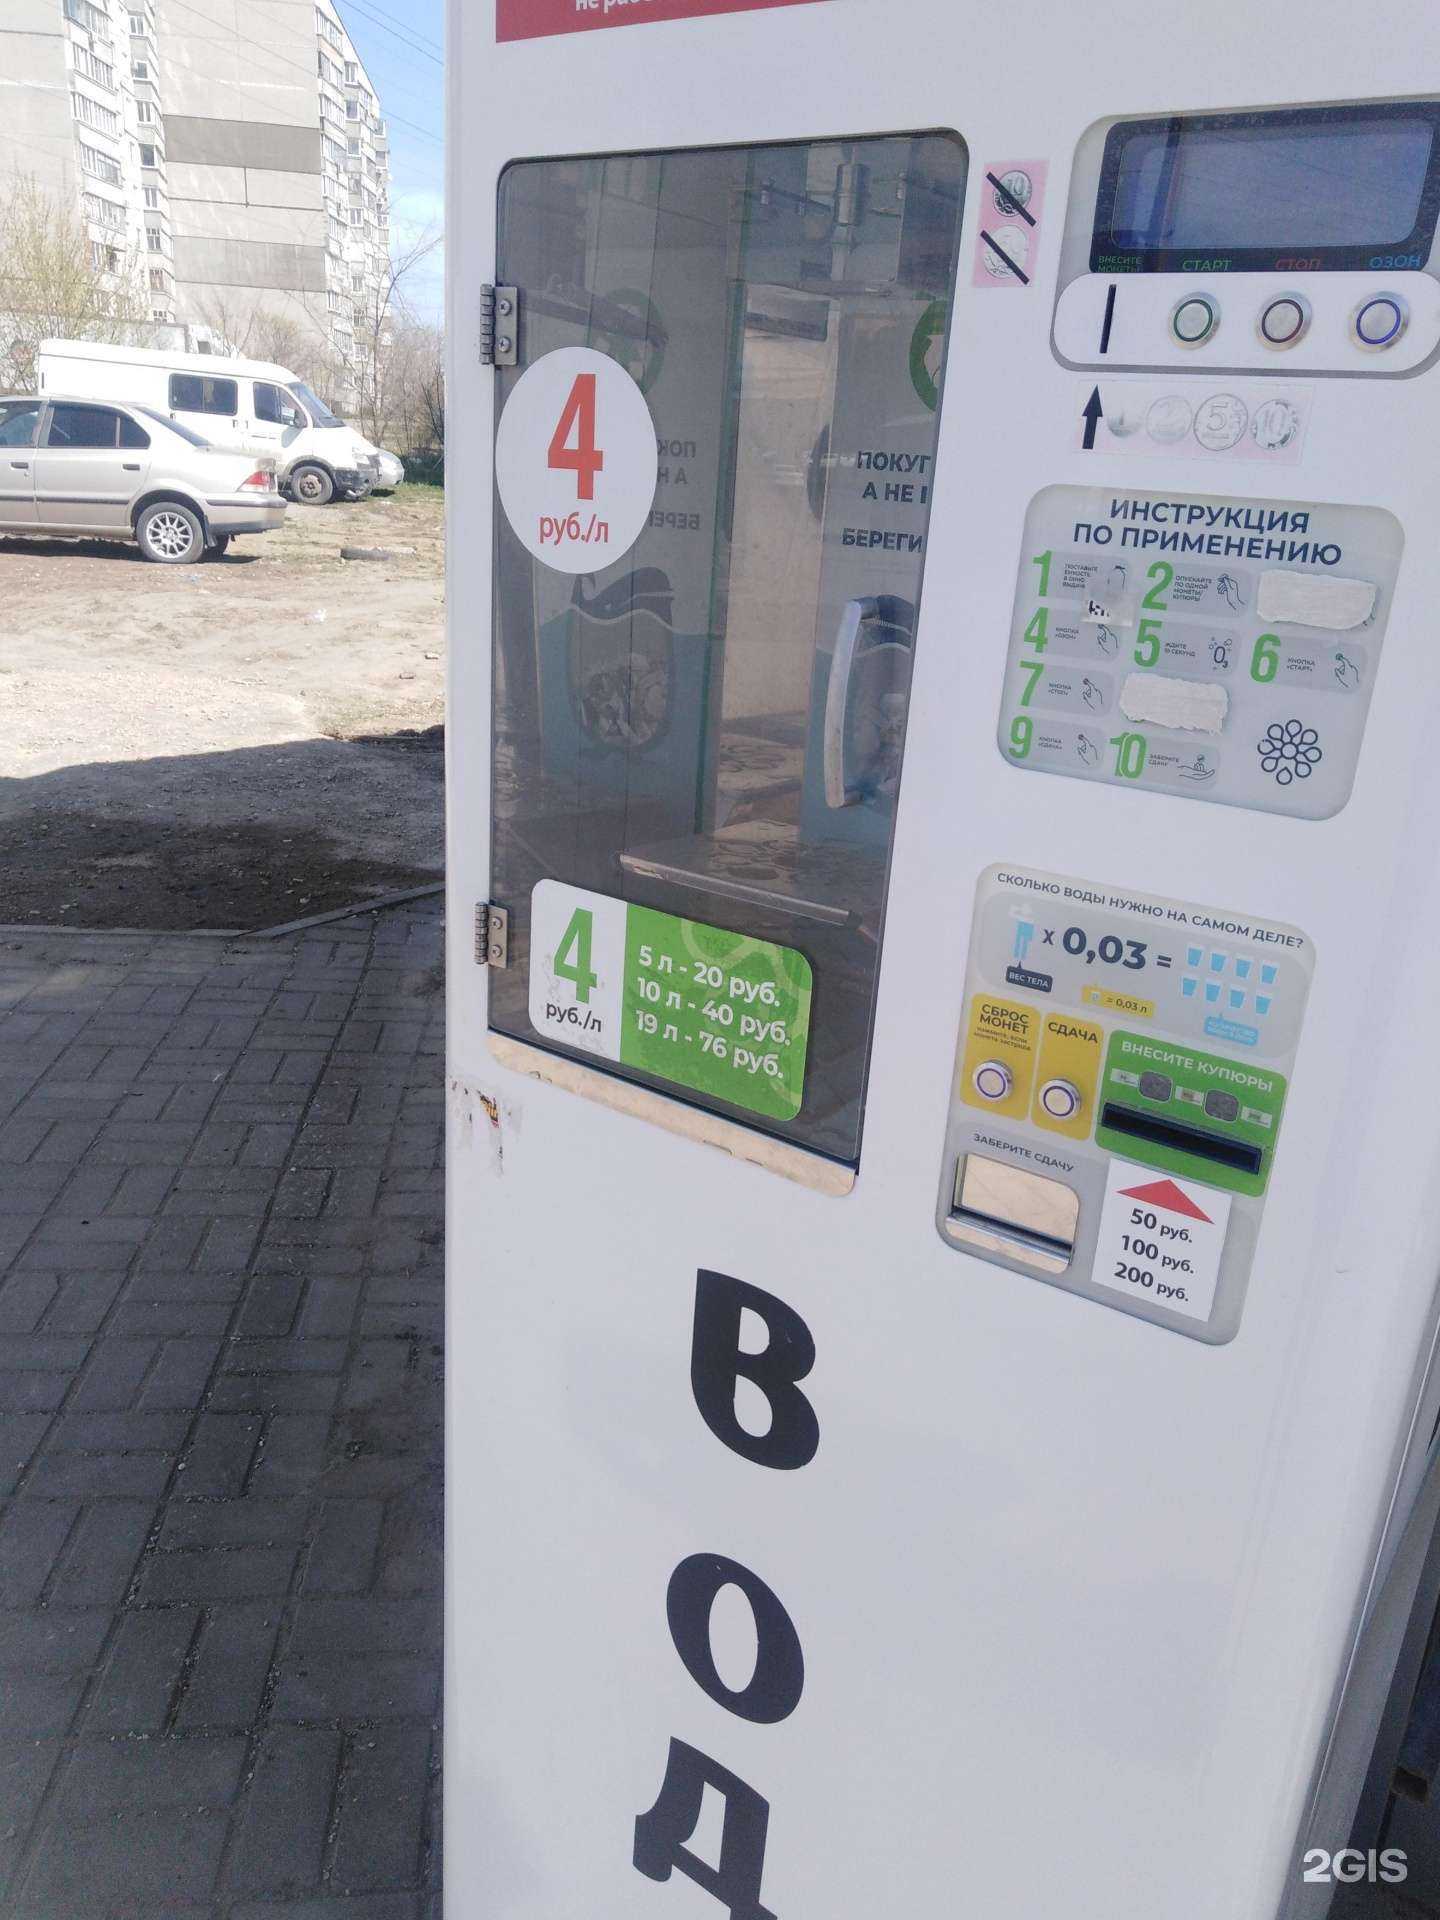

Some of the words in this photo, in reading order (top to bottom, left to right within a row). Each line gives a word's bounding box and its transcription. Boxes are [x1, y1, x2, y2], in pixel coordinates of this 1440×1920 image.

[1182, 259, 1232, 272] СТАРТ
[1275, 258, 1321, 271] СТОП
[1368, 255, 1422, 269] ОЗОН
[547, 373, 604, 501] 4
[862, 481, 878, 500] А
[884, 482, 914, 503] НЕ
[538, 511, 609, 546] руб./л
[1110, 499, 1310, 534] ИНСТРУКЦИЯ
[1073, 523, 1113, 545] ПО
[1120, 526, 1342, 566] ПРИМЕНЕНИЮ
[1032, 550, 1053, 597] 1
[1141, 561, 1174, 611] 2
[1023, 607, 1049, 654] 4
[1134, 618, 1163, 668] 5
[1250, 633, 1281, 683] 6
[1020, 660, 1044, 707] 7
[1008, 715, 1034, 759] 9
[1110, 732, 1147, 779] 10
[997, 872, 1060, 894] СКОЛЬКО
[1063, 887, 1105, 905] ВОДЫ
[1109, 897, 1163, 917] НУЖНО
[1167, 909, 1187, 923] НА
[1192, 915, 1249, 937] САМОМ
[1252, 928, 1304, 949] ДЕЛЕ?
[553, 907, 598, 1004] 4
[1062, 926, 1147, 970] 0,03
[638, 944, 652, 967] 5
[657, 955, 673, 973] л
[693, 961, 723, 988] 20
[729, 975, 781, 1008] руб.
[1009, 971, 1025, 982] ВЕС
[1026, 976, 1049, 988] ТЕЛА
[545, 1000, 602, 1033] руб./л
[637, 977, 661, 1003] 10
[665, 990, 682, 1010] л
[702, 999, 734, 1026] 40
[740, 1014, 792, 1047] руб.
[979, 1013, 1029, 1035] МОНЕТ
[981, 1003, 1029, 1025] СБРОС
[1115, 998, 1138, 1011] 0,03
[636, 1009, 658, 1034] 19
[663, 1022, 679, 1042] л
[699, 1030, 728, 1059] 76
[732, 1046, 784, 1079] руб.
[1047, 1021, 1098, 1044] СДАЧА
[1121, 1039, 1194, 1070] ВНЕСИТЕ
[1197, 1060, 1273, 1093] КУПЮРЫ
[973, 1133, 1032, 1158] ЗАБЕРИТЕ
[1034, 1153, 1074, 1173] СДАЧУ
[1130, 1207, 1157, 1230] 50
[1160, 1224, 1193, 1243] руб.
[1121, 1234, 1159, 1260] 100
[1161, 1254, 1194, 1274] руб.
[1114, 1261, 1154, 1288] 200
[1156, 1282, 1189, 1302] руб.
